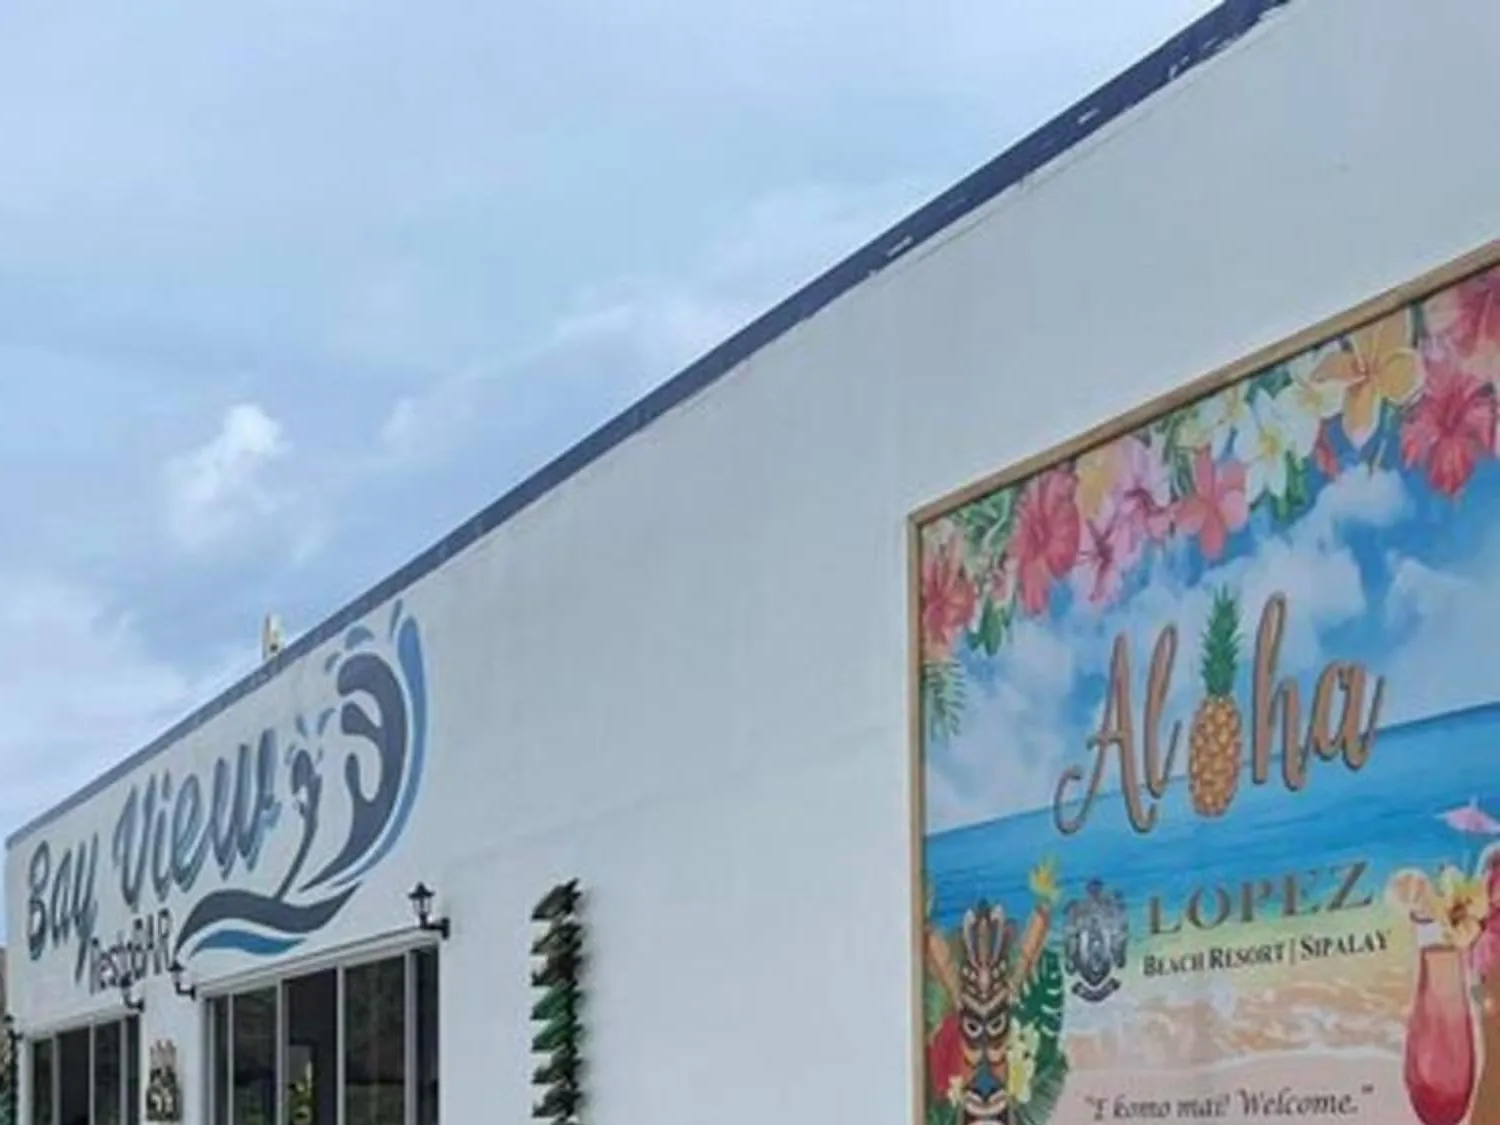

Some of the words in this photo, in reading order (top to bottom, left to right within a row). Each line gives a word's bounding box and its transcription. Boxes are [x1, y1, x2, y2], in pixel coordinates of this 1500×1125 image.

[1054, 590, 1385, 833] Aloha
[28, 831, 99, 985] Bay
[113, 729, 282, 913] View
[1149, 861, 1373, 936] LOPEZ
